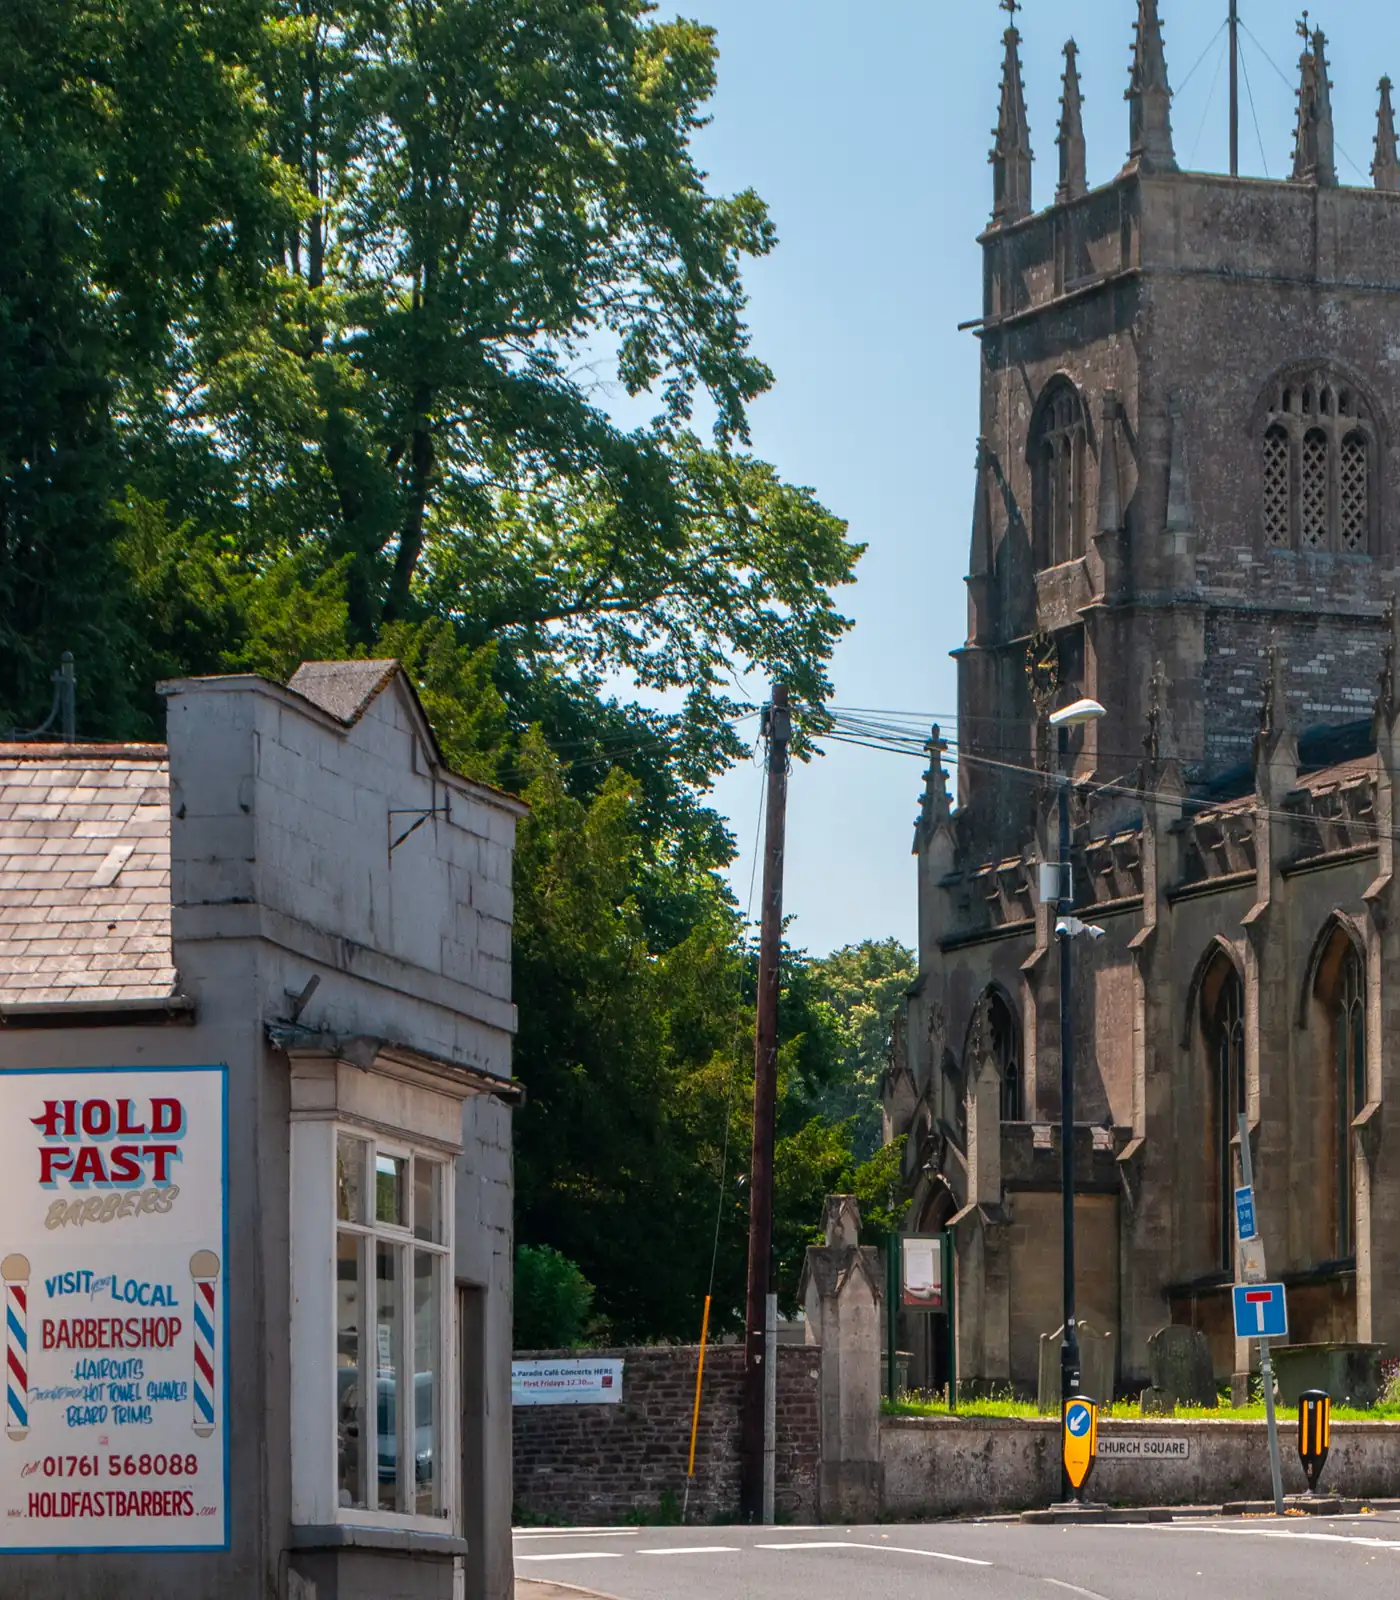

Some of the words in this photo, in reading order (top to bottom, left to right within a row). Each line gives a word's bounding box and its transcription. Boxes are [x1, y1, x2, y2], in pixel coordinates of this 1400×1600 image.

[29, 1097, 185, 1140] HOLD
[38, 1145, 182, 1189] FAST
[44, 1184, 180, 1230] BARBERS
[45, 1270, 94, 1298] VISIT
[111, 1274, 179, 1306] LOCAL
[42, 1317, 182, 1350] BARBERSHOP
[74, 1358, 144, 1380] HAIRCUTS
[561, 1368, 592, 1376] Concerts
[83, 1382, 105, 1402] HOT
[107, 1383, 141, 1402] TOWEL
[146, 1380, 188, 1402] SHAVES
[523, 1380, 539, 1388] First
[541, 1379, 565, 1388] Fridays
[66, 1405, 108, 1427] BEARD
[112, 1405, 153, 1425] TRIMS
[1098, 1442, 1140, 1454] CHURCH
[1143, 1442, 1185, 1454] SQUARE
[43, 1455, 98, 1477] 01761
[108, 1453, 198, 1476] 568088
